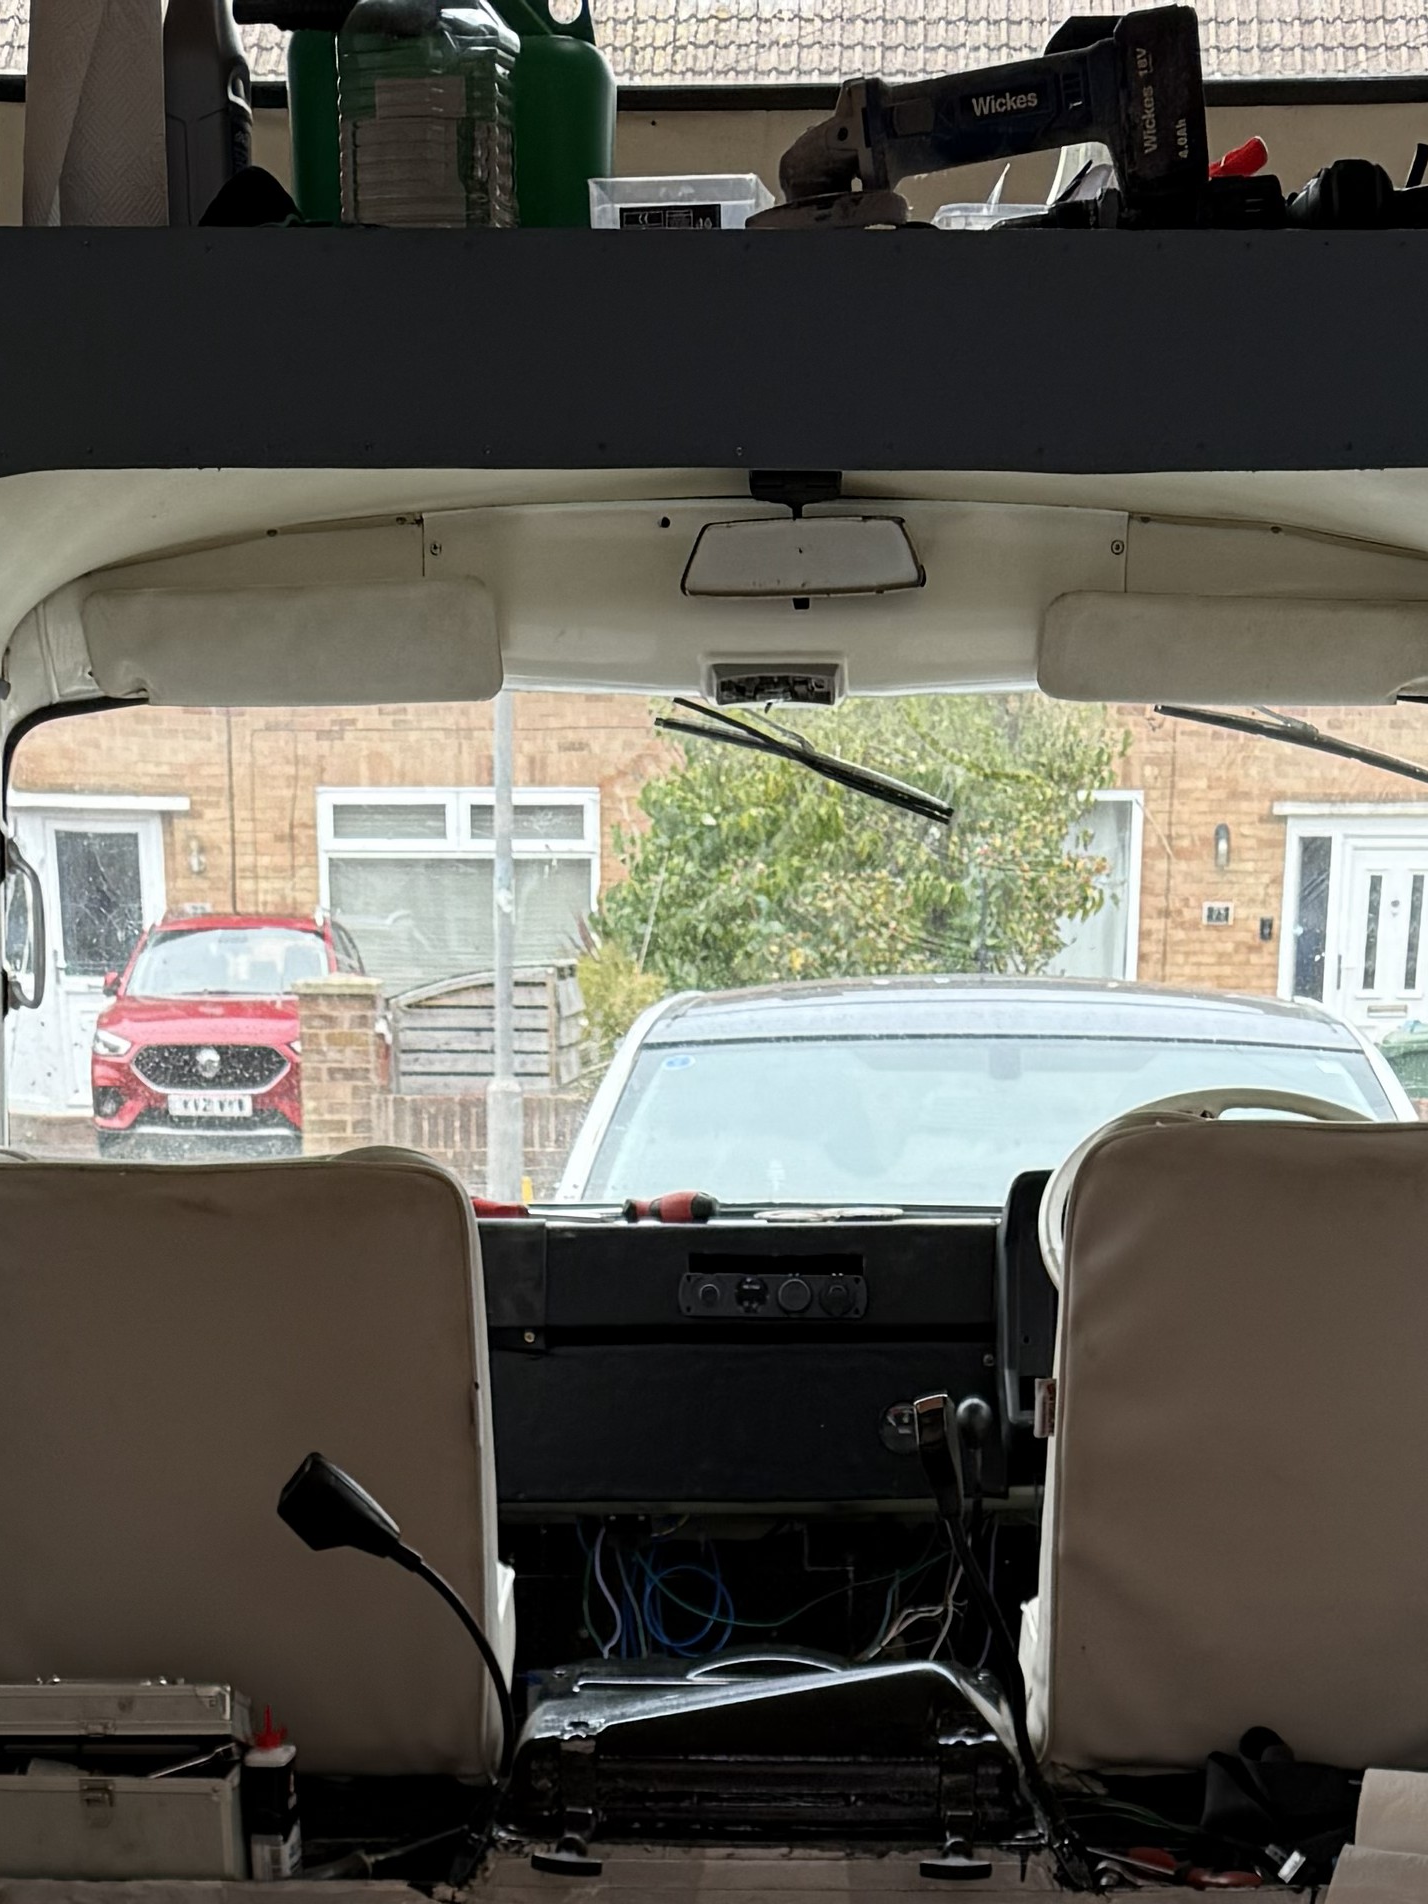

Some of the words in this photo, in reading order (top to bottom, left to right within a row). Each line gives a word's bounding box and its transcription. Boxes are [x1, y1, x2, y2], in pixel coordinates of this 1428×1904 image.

[1136, 47, 1148, 79] 18V
[972, 91, 1038, 118] Wickes
[1142, 85, 1157, 154] Wickes
